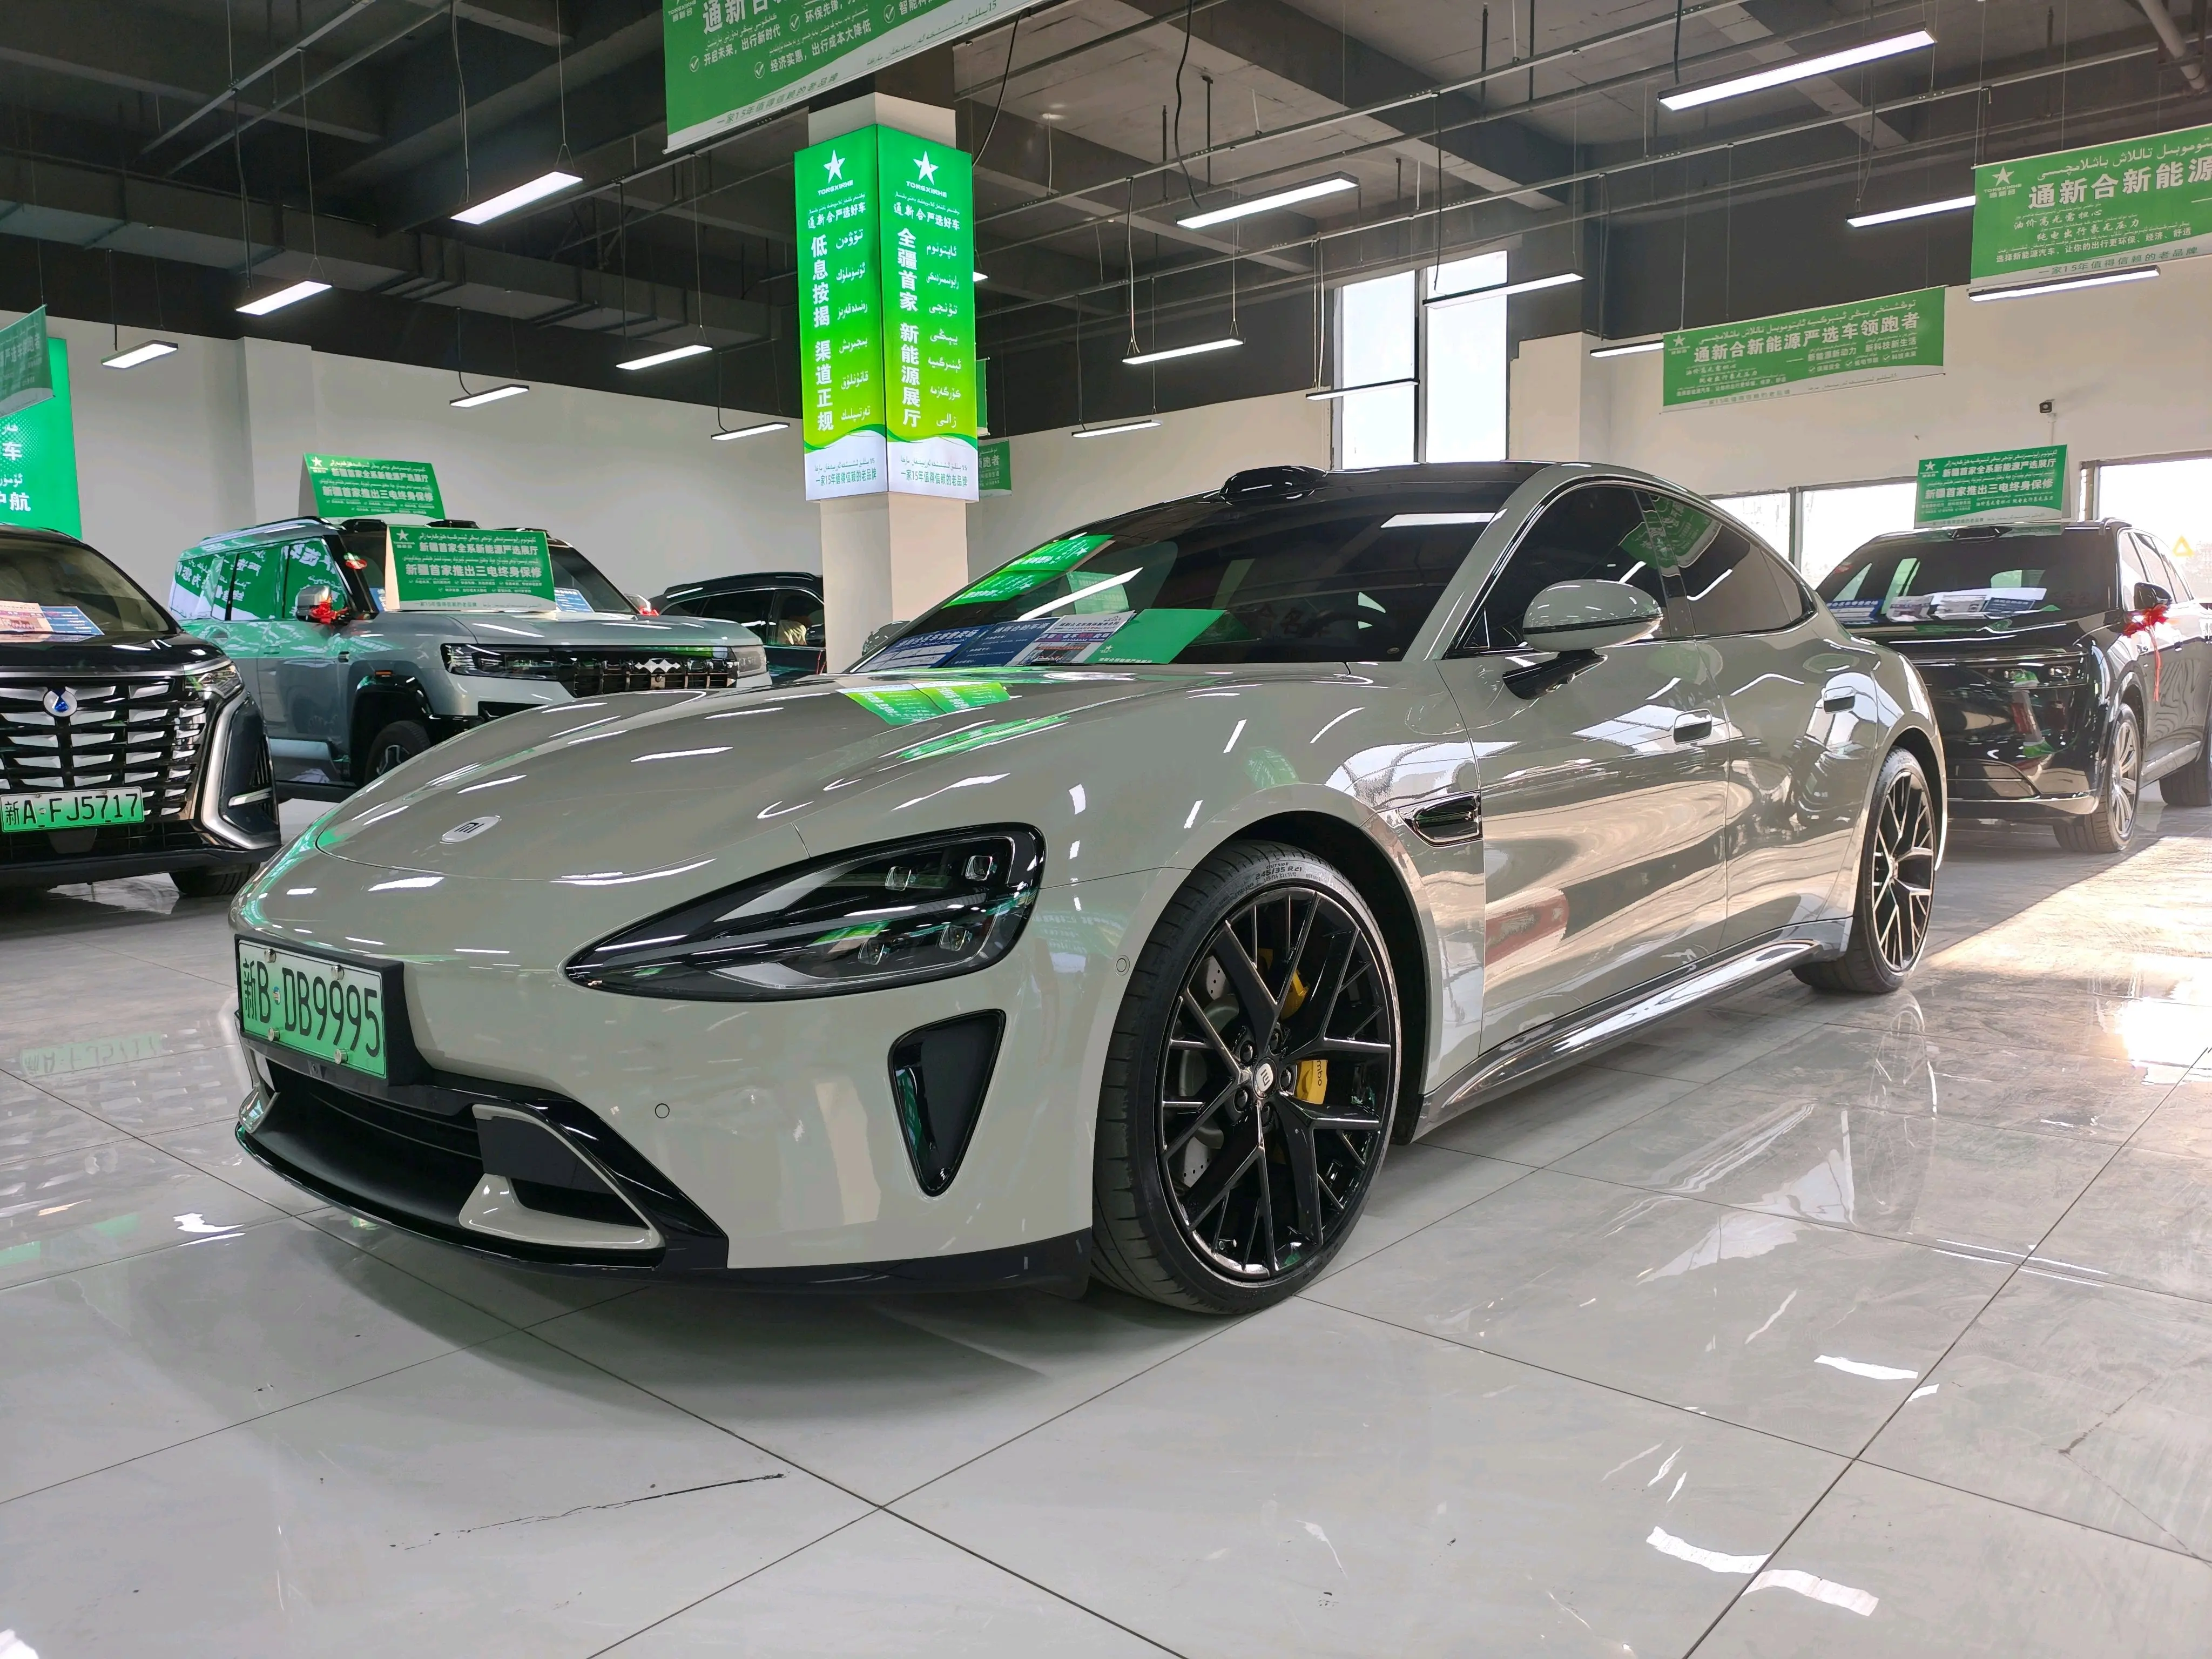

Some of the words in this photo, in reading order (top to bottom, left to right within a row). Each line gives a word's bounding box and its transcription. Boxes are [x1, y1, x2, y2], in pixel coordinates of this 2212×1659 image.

[2028, 155, 2212, 210] 通新合新能源
[2014, 209, 2102, 230] 油价高无需担心
[898, 227, 918, 312] 全疆首家
[2039, 246, 2198, 275] 一家15年值得信赖的老品牌
[811, 234, 830, 328] 低息按揭
[1694, 312, 1920, 363] 通新合新能源严选车领跑者
[815, 340, 834, 431] 渠道正规
[900, 322, 921, 427] 新能源展厅
[815, 468, 877, 486] 一家15年值得信赖的老品牌
[901, 469, 968, 488] 一家15年值得信赖的老品牌
[1925, 478, 2053, 500] 新疆首家推出三电终身保修
[419, 542, 538, 556] 新疆首家全系新能源严选展厅
[406, 563, 542, 578] 新疆首家推出三电终身保修
